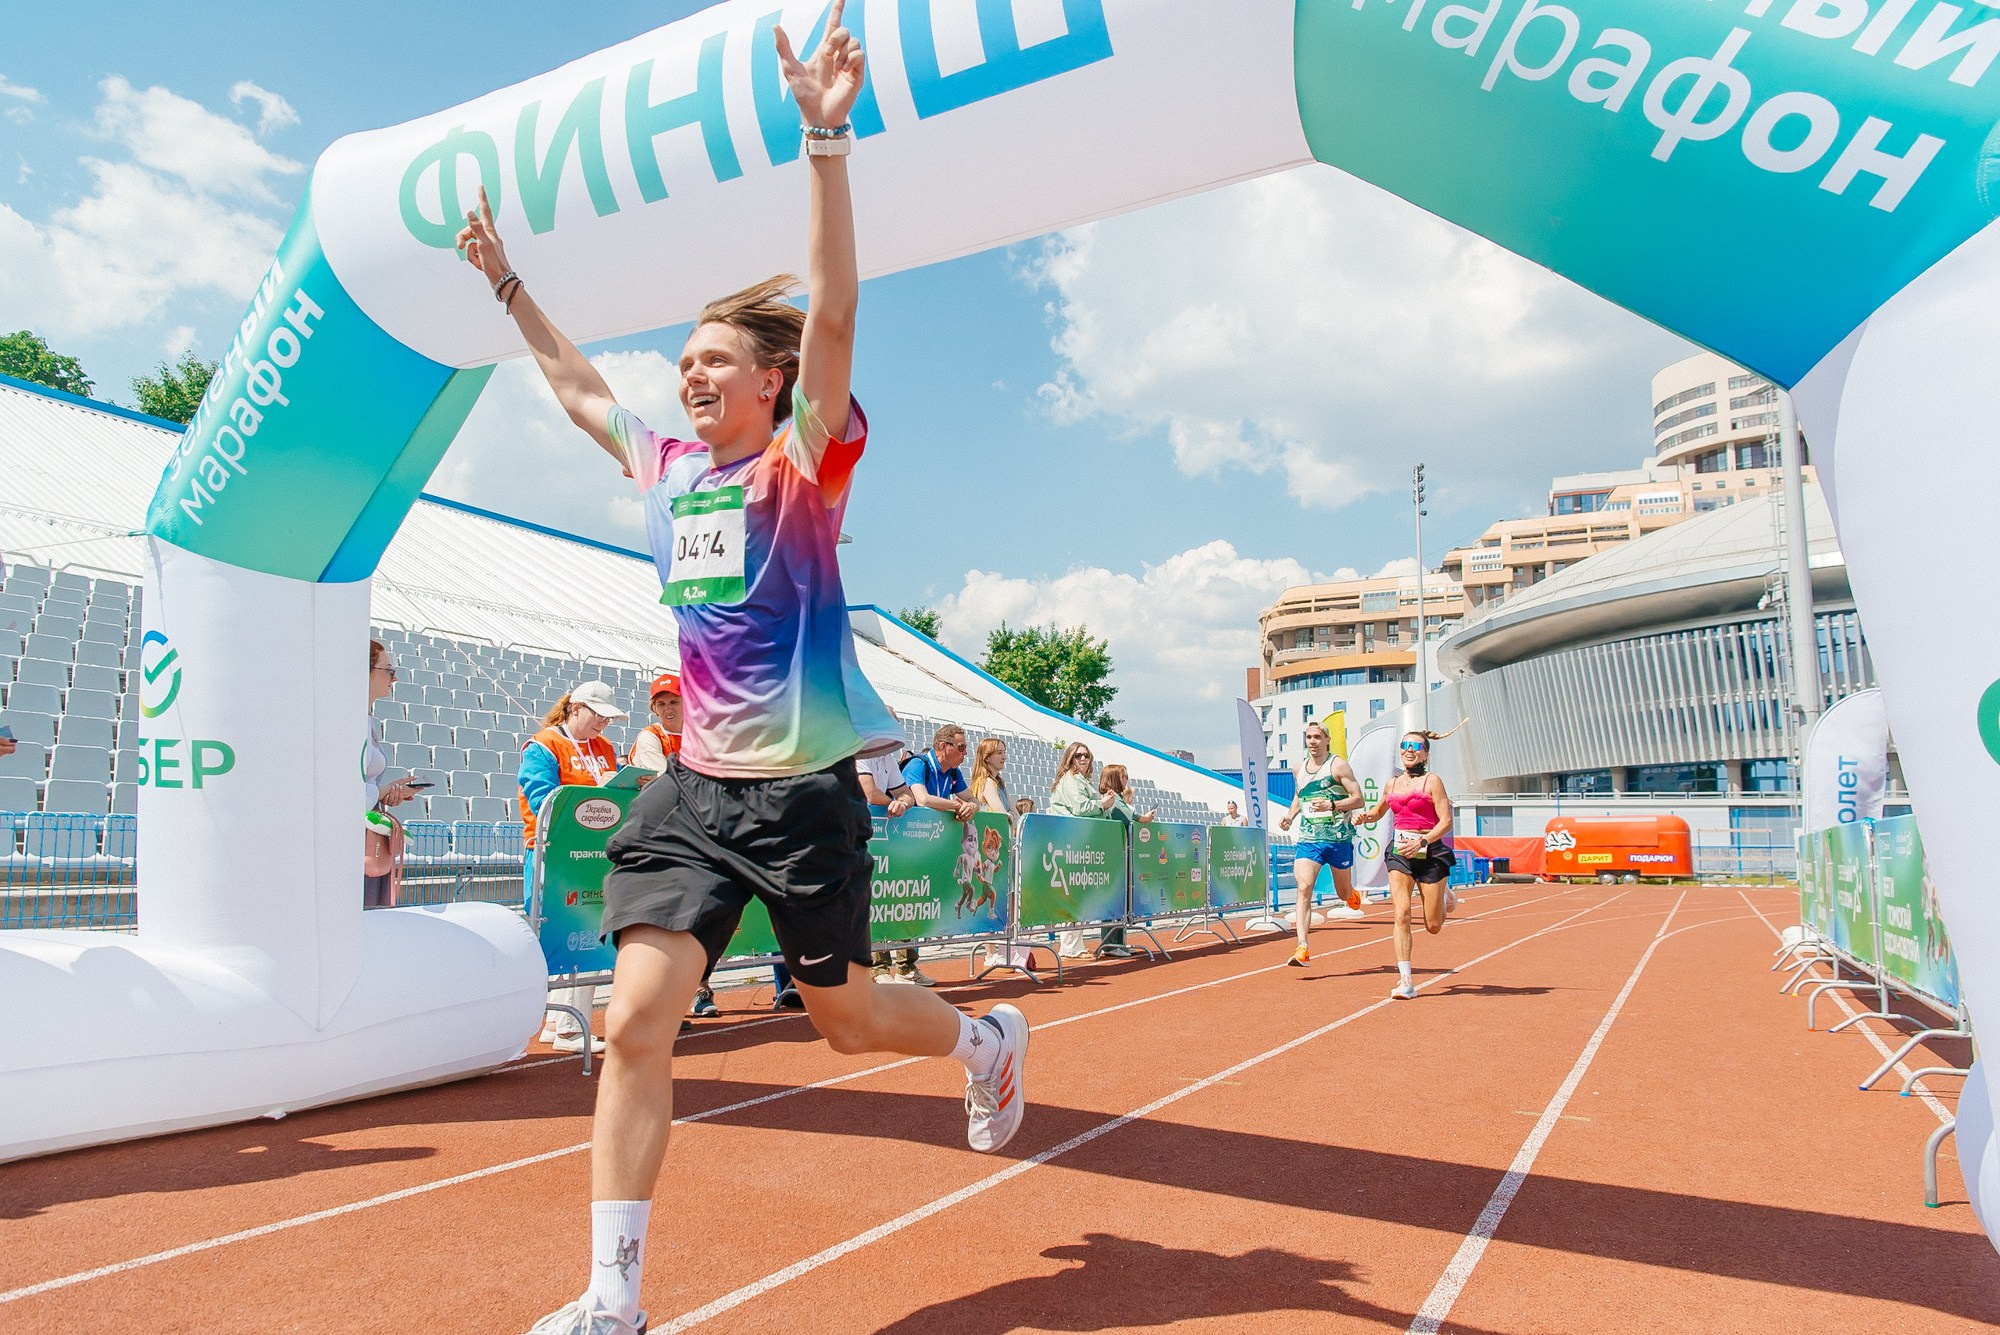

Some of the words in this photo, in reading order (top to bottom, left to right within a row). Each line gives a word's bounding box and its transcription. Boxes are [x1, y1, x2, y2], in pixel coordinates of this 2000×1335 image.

[398, 0, 1115, 262] ФИНИШ
[179, 286, 326, 526] марафон
[677, 530, 725, 562] 0474
[1248, 756, 1263, 829] олет
[585, 803, 612, 815] Деревня
[1629, 854, 1674, 863] ПОДАРКИ
[870, 875, 931, 899] ОМОГАЙ
